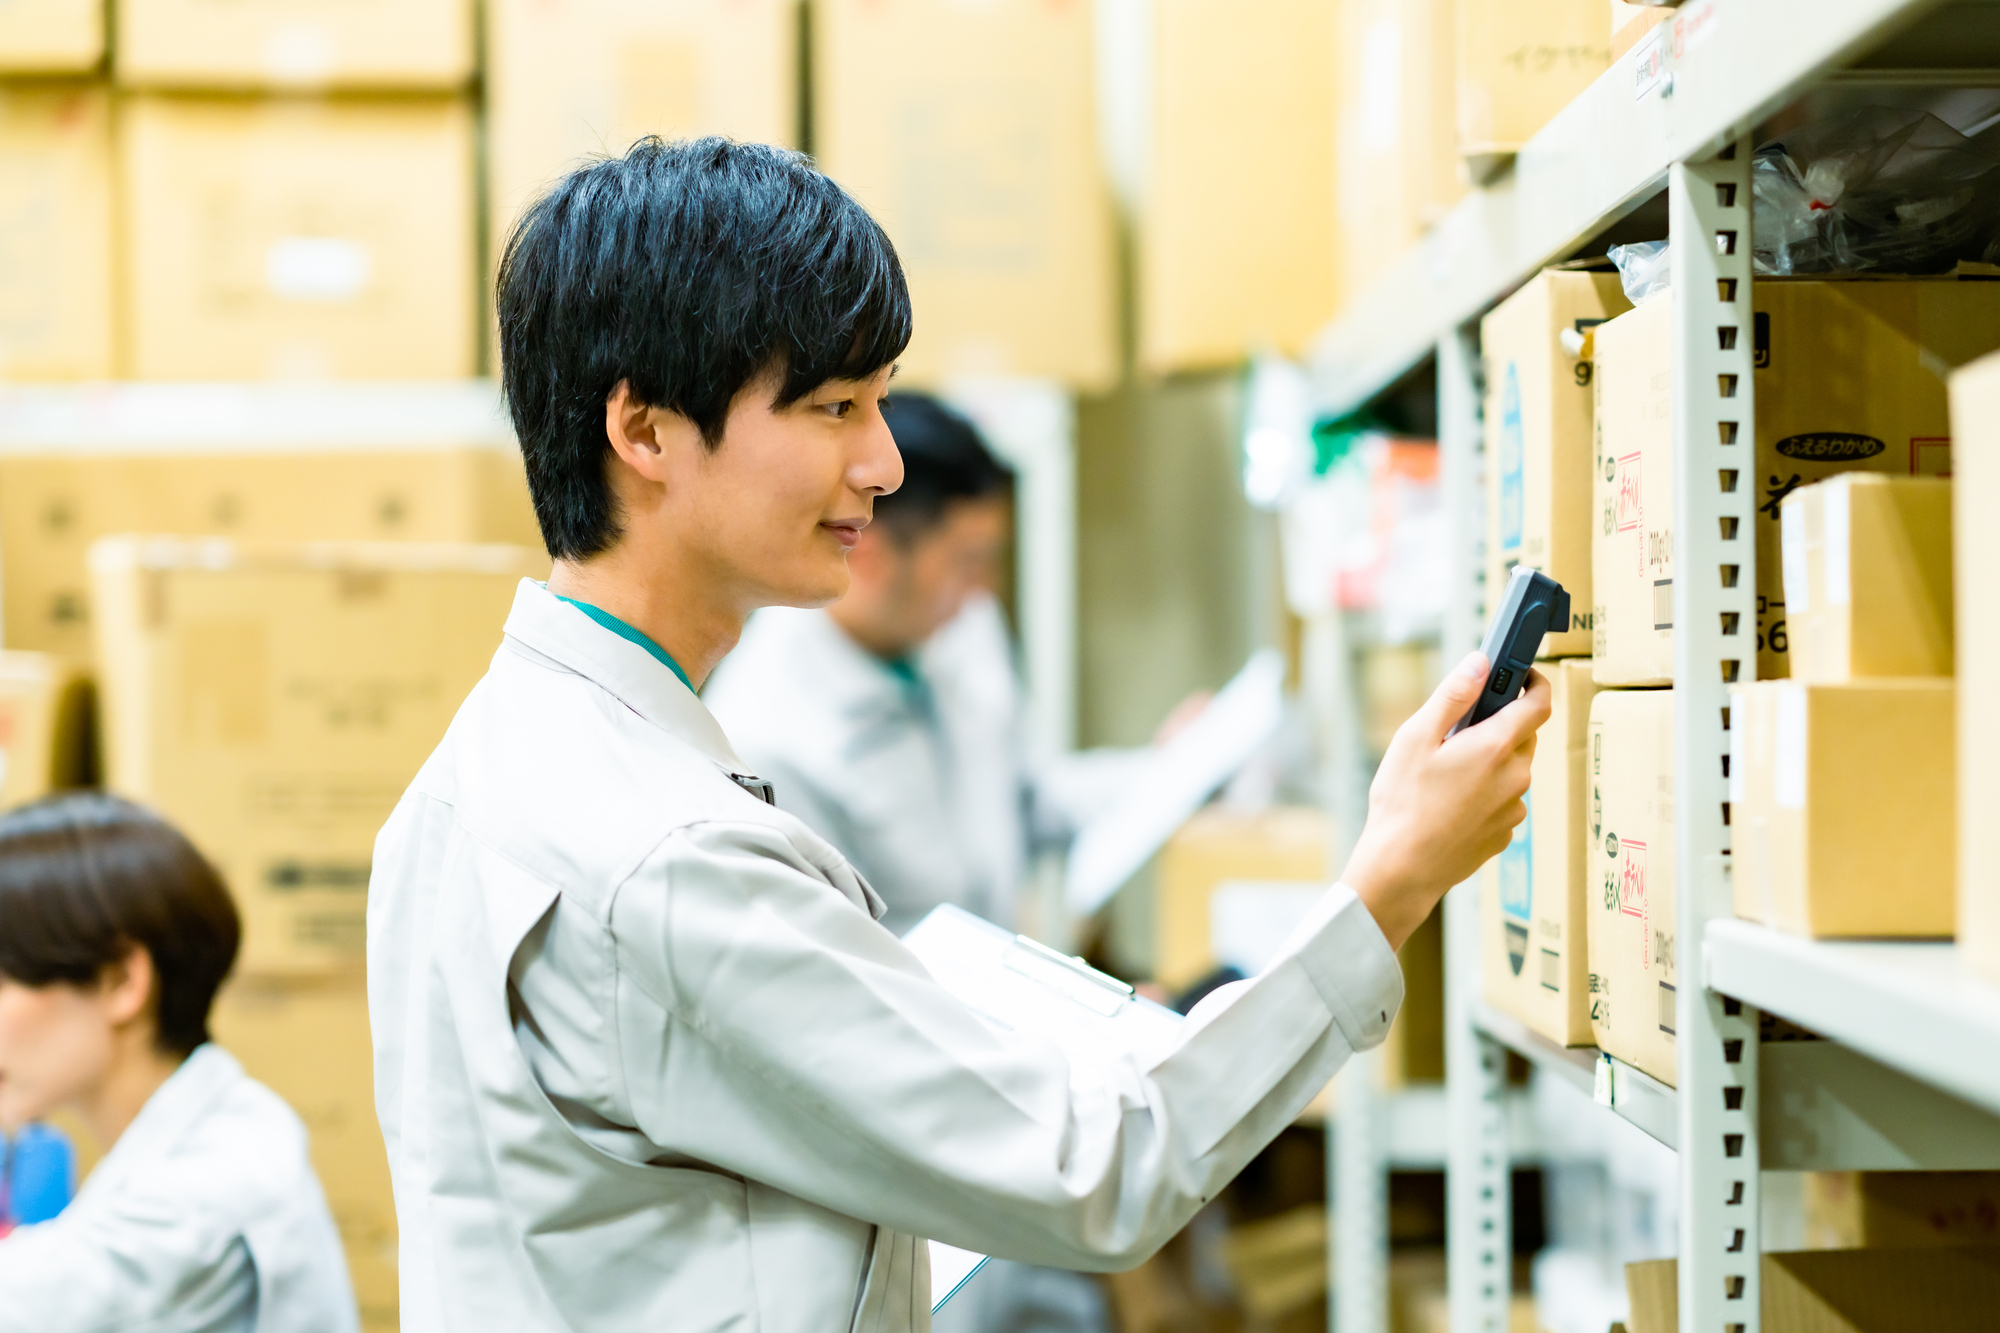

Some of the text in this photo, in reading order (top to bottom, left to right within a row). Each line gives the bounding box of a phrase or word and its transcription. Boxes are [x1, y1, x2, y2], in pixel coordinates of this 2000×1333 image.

[1783, 435, 1877, 456] ふえるわかめ
